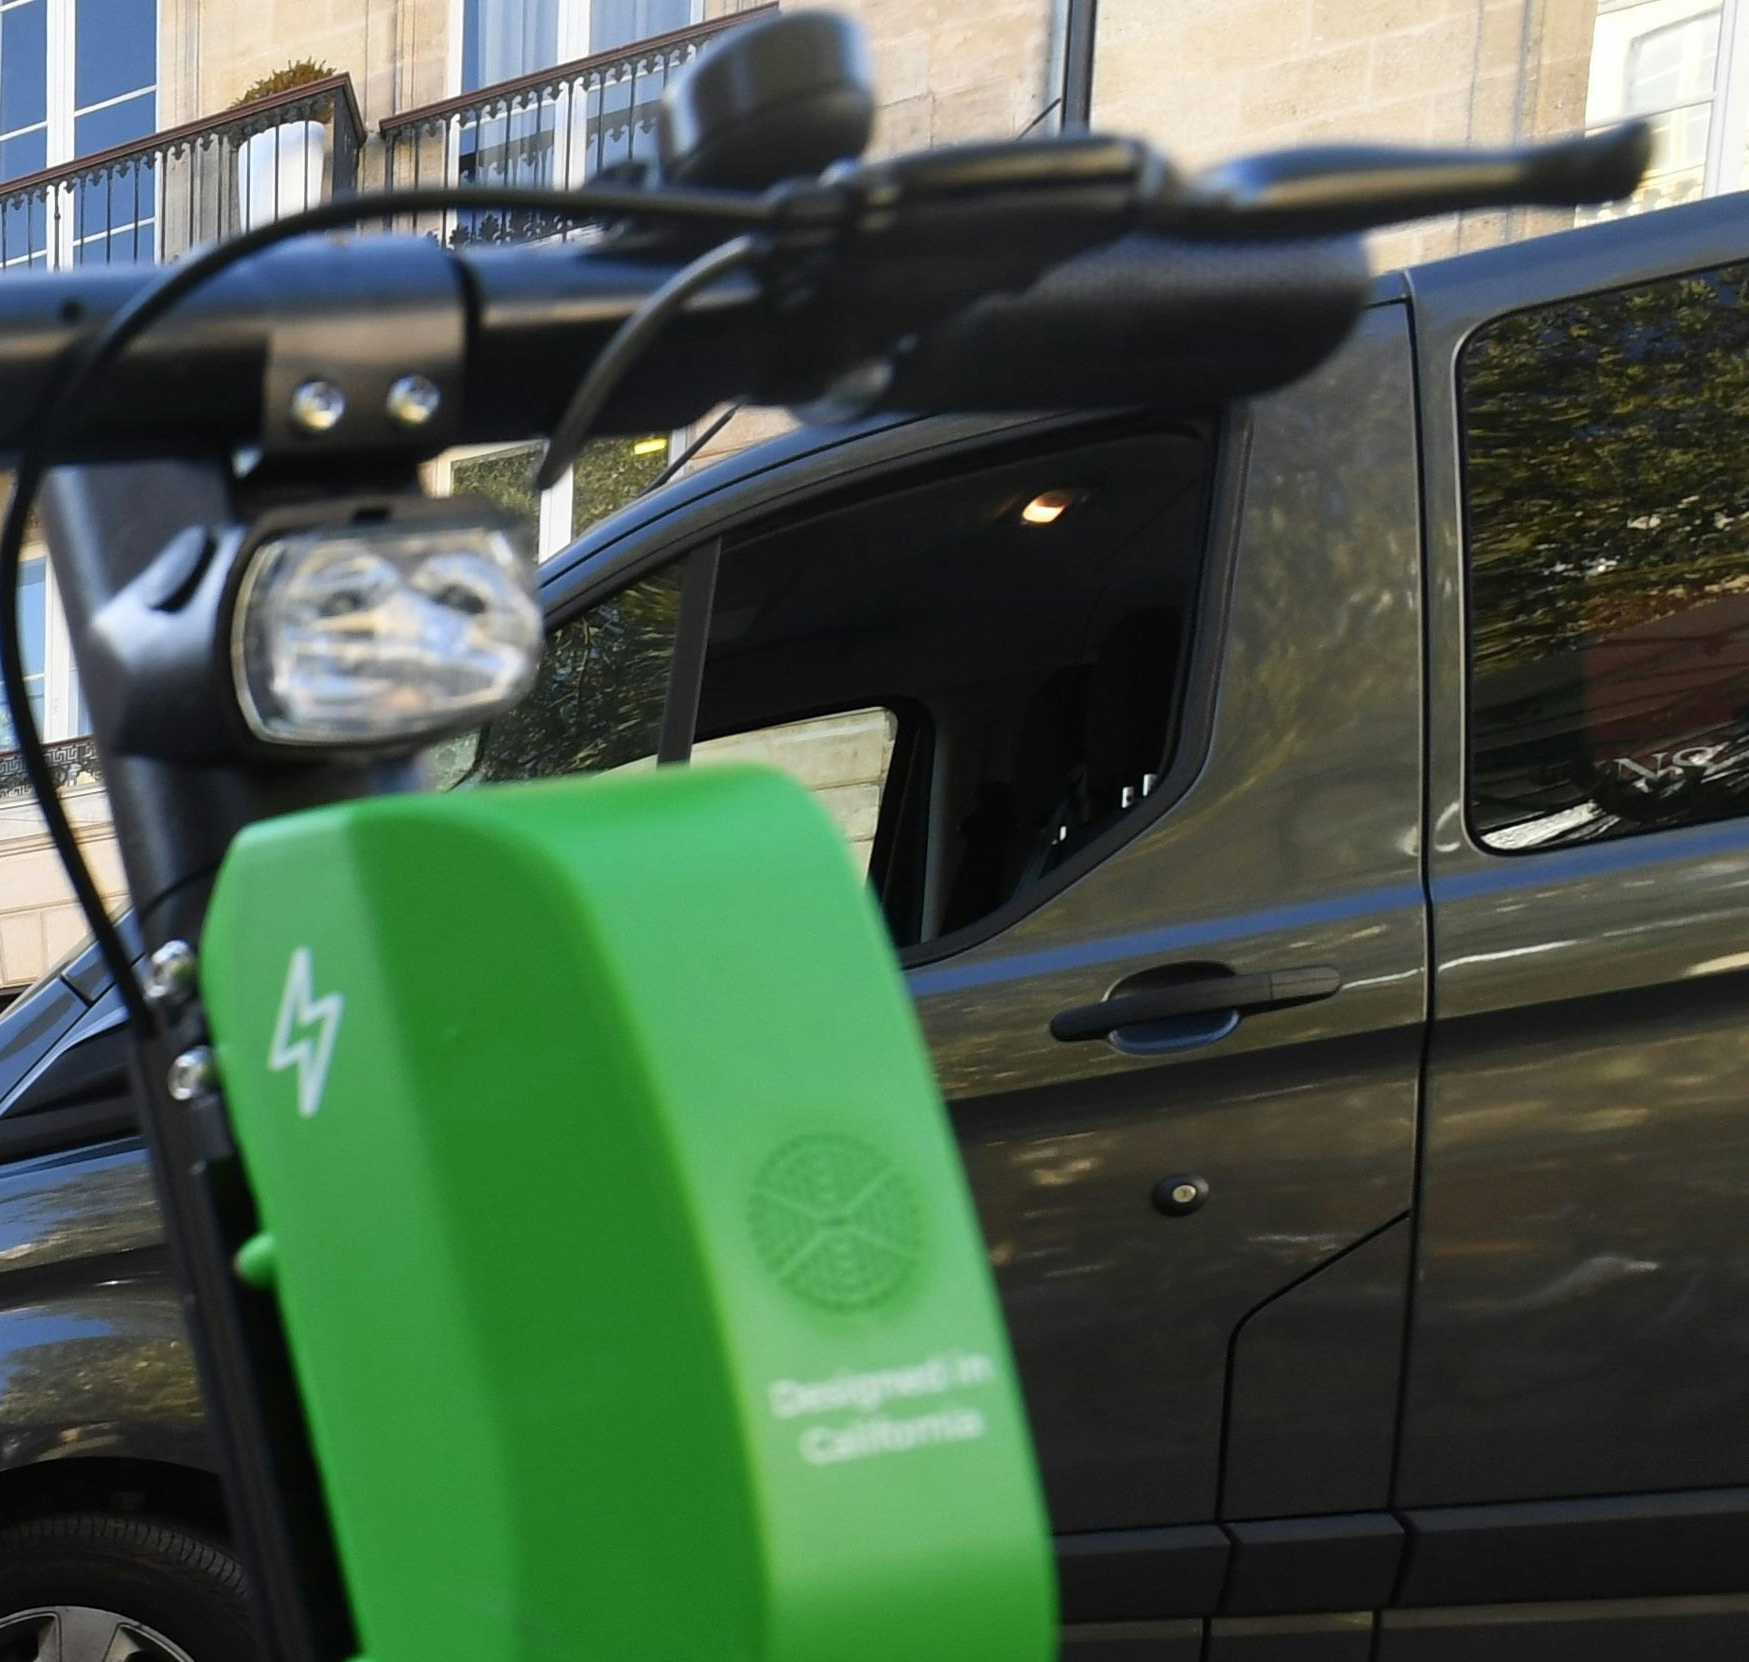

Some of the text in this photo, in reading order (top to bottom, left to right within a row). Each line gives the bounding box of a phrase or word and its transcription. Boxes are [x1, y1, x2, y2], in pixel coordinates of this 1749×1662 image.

[767, 1352, 997, 1420] Designed in
[800, 1406, 986, 1465] California
